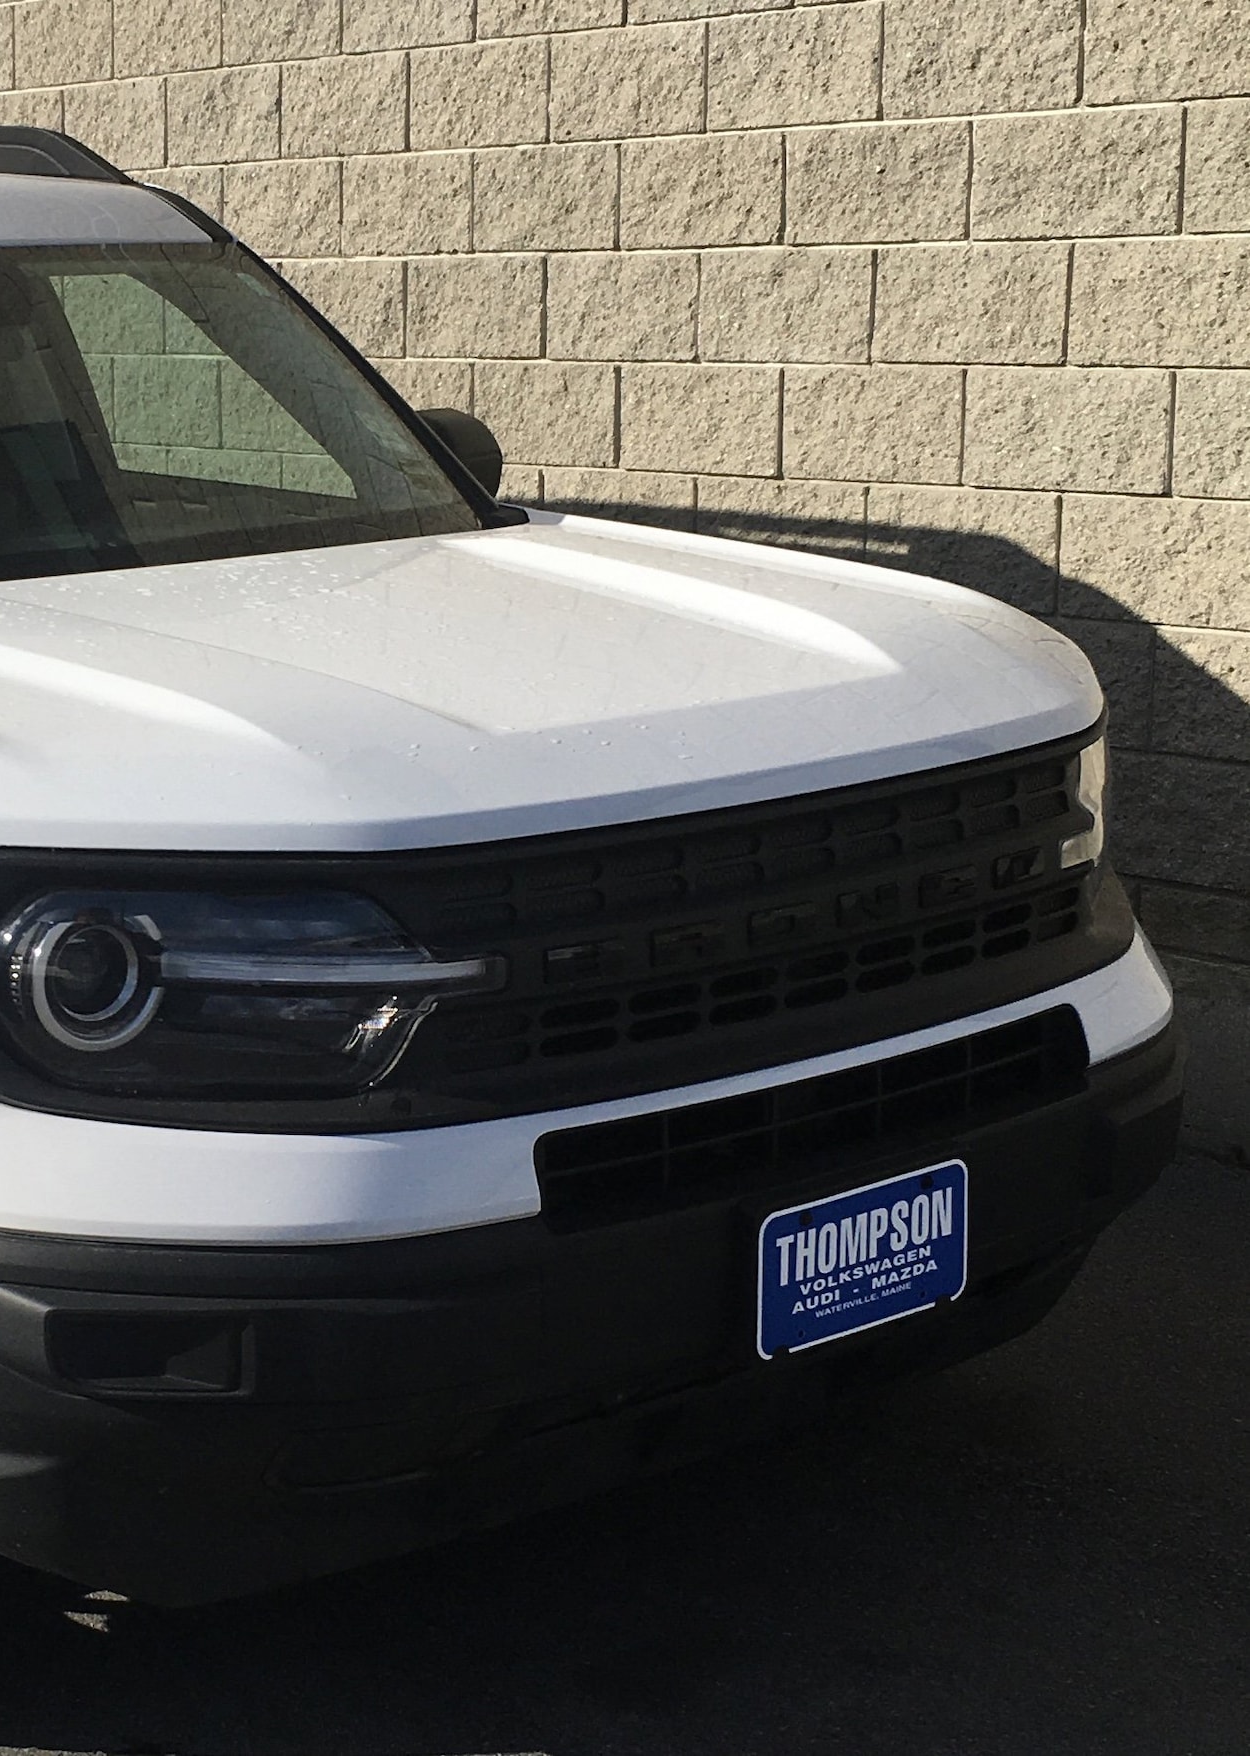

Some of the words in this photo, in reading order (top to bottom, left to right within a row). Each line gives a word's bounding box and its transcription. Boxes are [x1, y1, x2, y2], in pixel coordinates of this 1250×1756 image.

[776, 1187, 953, 1286] THOMPSON
[791, 1289, 840, 1315] AUDI
[871, 1259, 938, 1290] MAZDA
[800, 1245, 932, 1296] VOLKSWAGEN
[881, 1281, 912, 1298] MAINE
